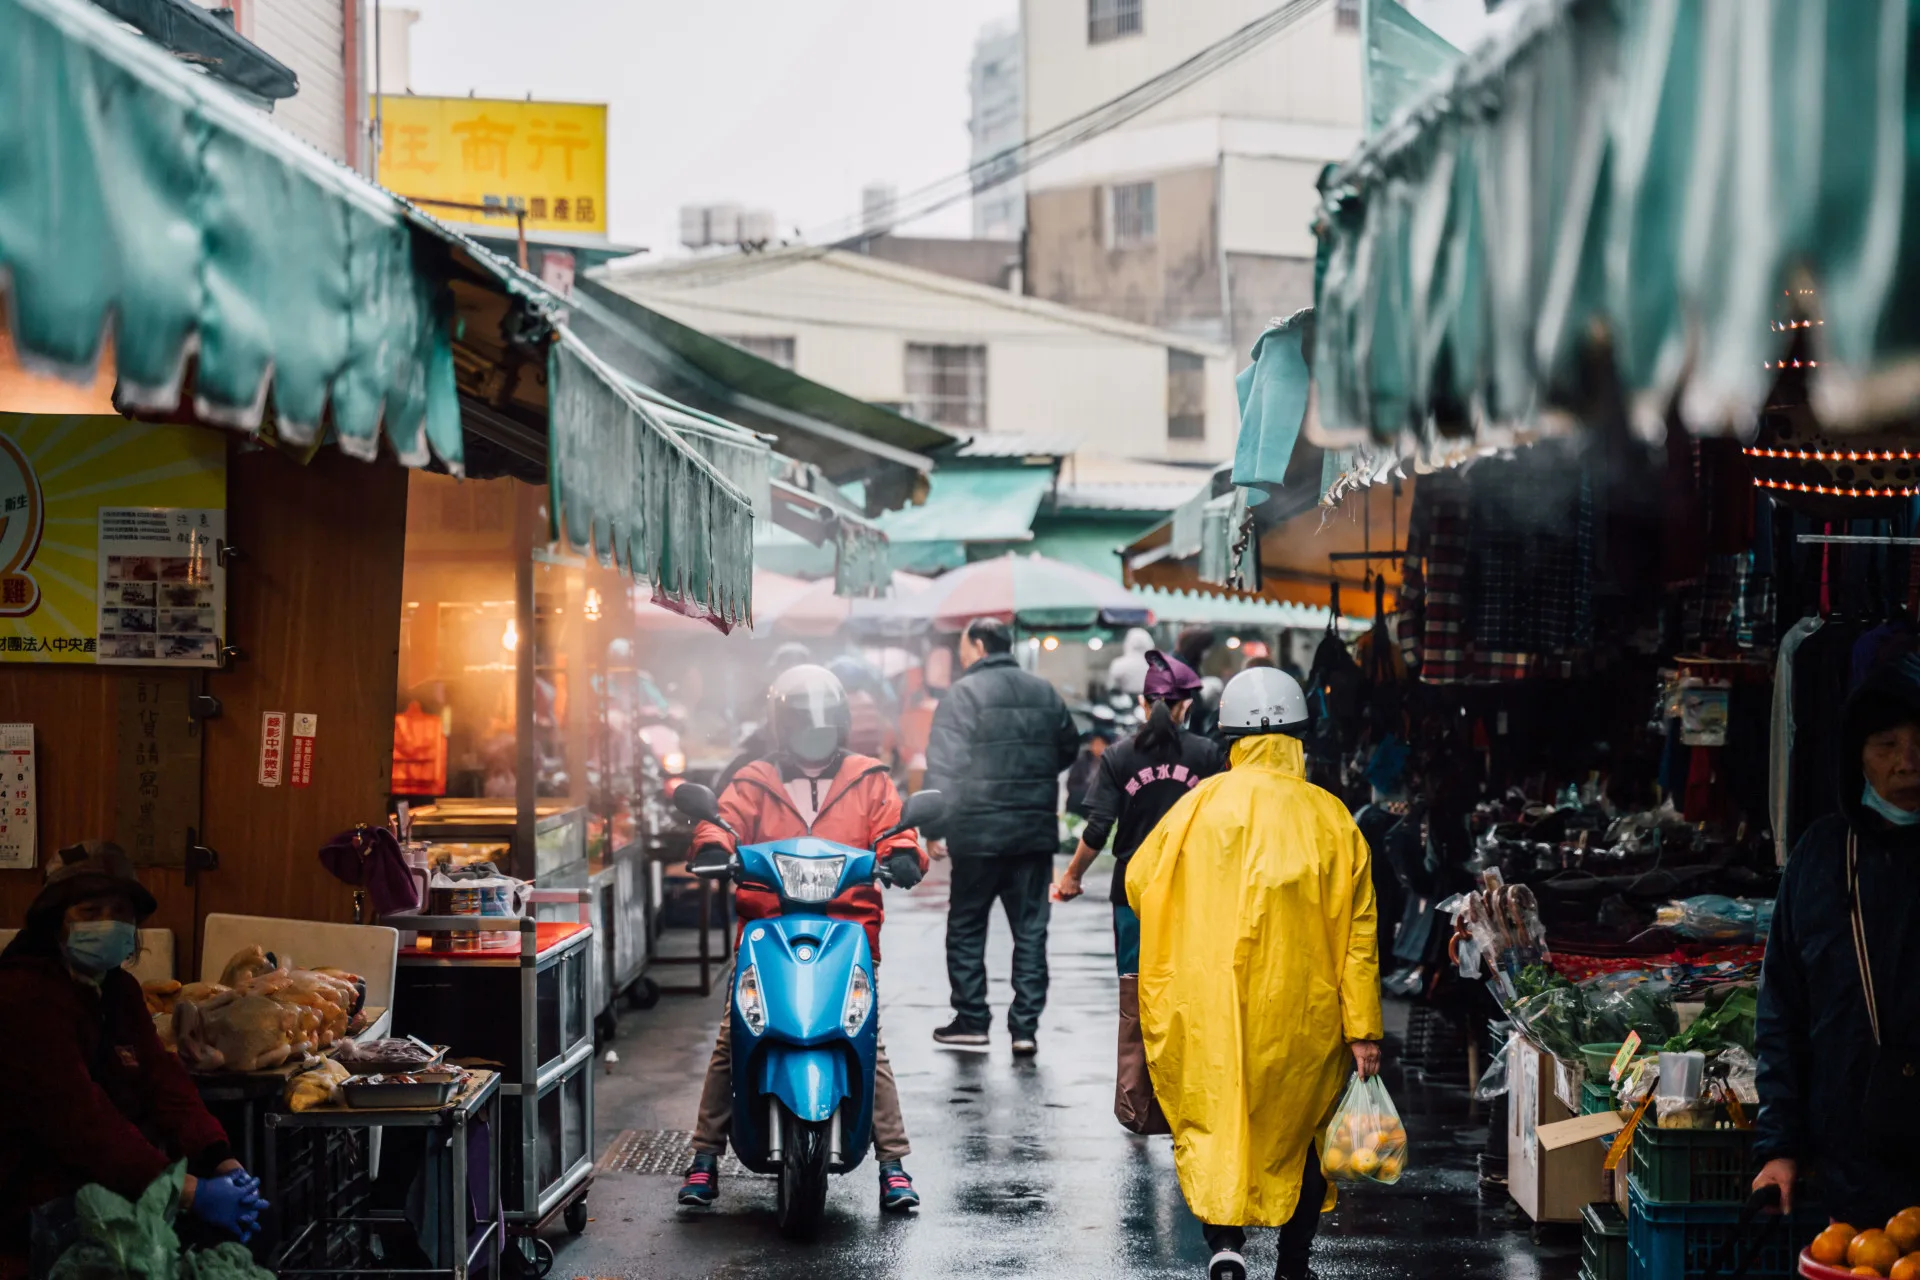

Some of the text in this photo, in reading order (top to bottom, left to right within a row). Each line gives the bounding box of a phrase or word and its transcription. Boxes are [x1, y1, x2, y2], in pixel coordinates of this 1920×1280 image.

[263, 717, 281, 780] 錄影中請微笑
[15, 790, 27, 798] 15
[15, 808, 27, 816] 22
